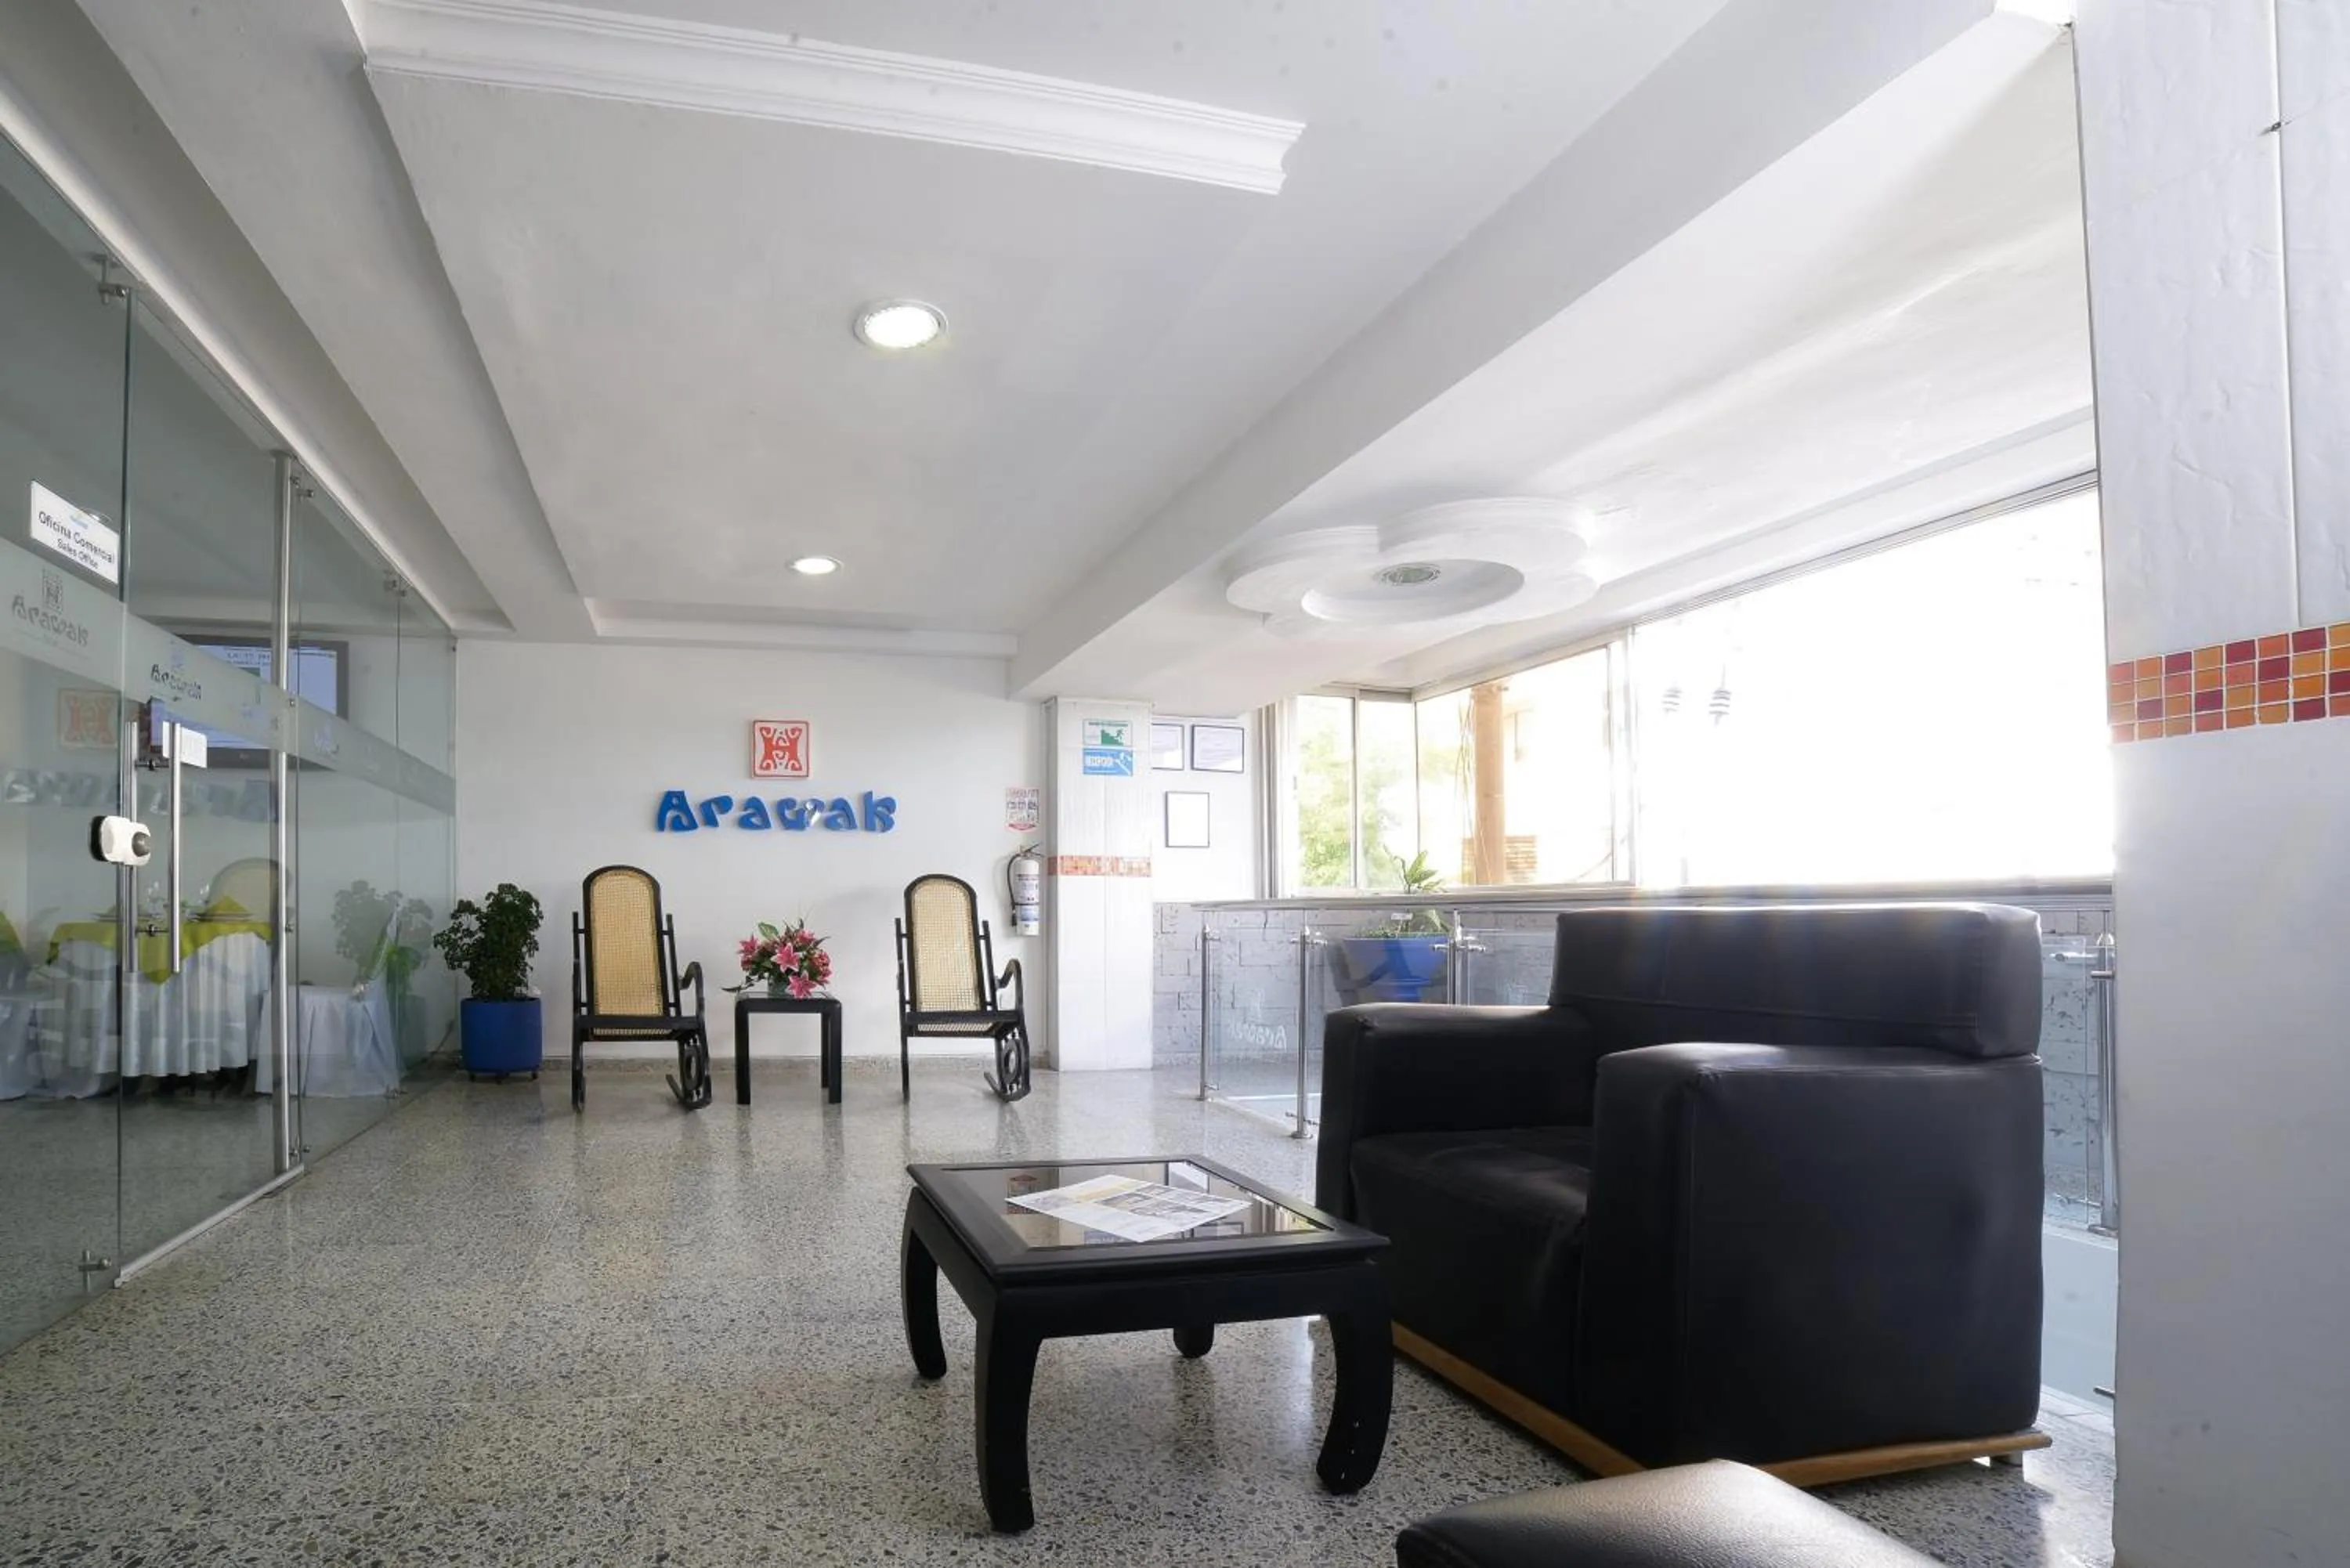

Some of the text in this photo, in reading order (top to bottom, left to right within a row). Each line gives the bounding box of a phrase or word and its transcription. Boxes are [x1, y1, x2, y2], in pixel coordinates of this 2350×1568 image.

[38, 511, 114, 565] Oficina Comercial
[57, 538, 77, 557] Sales
[657, 789, 897, 833] Arawak
